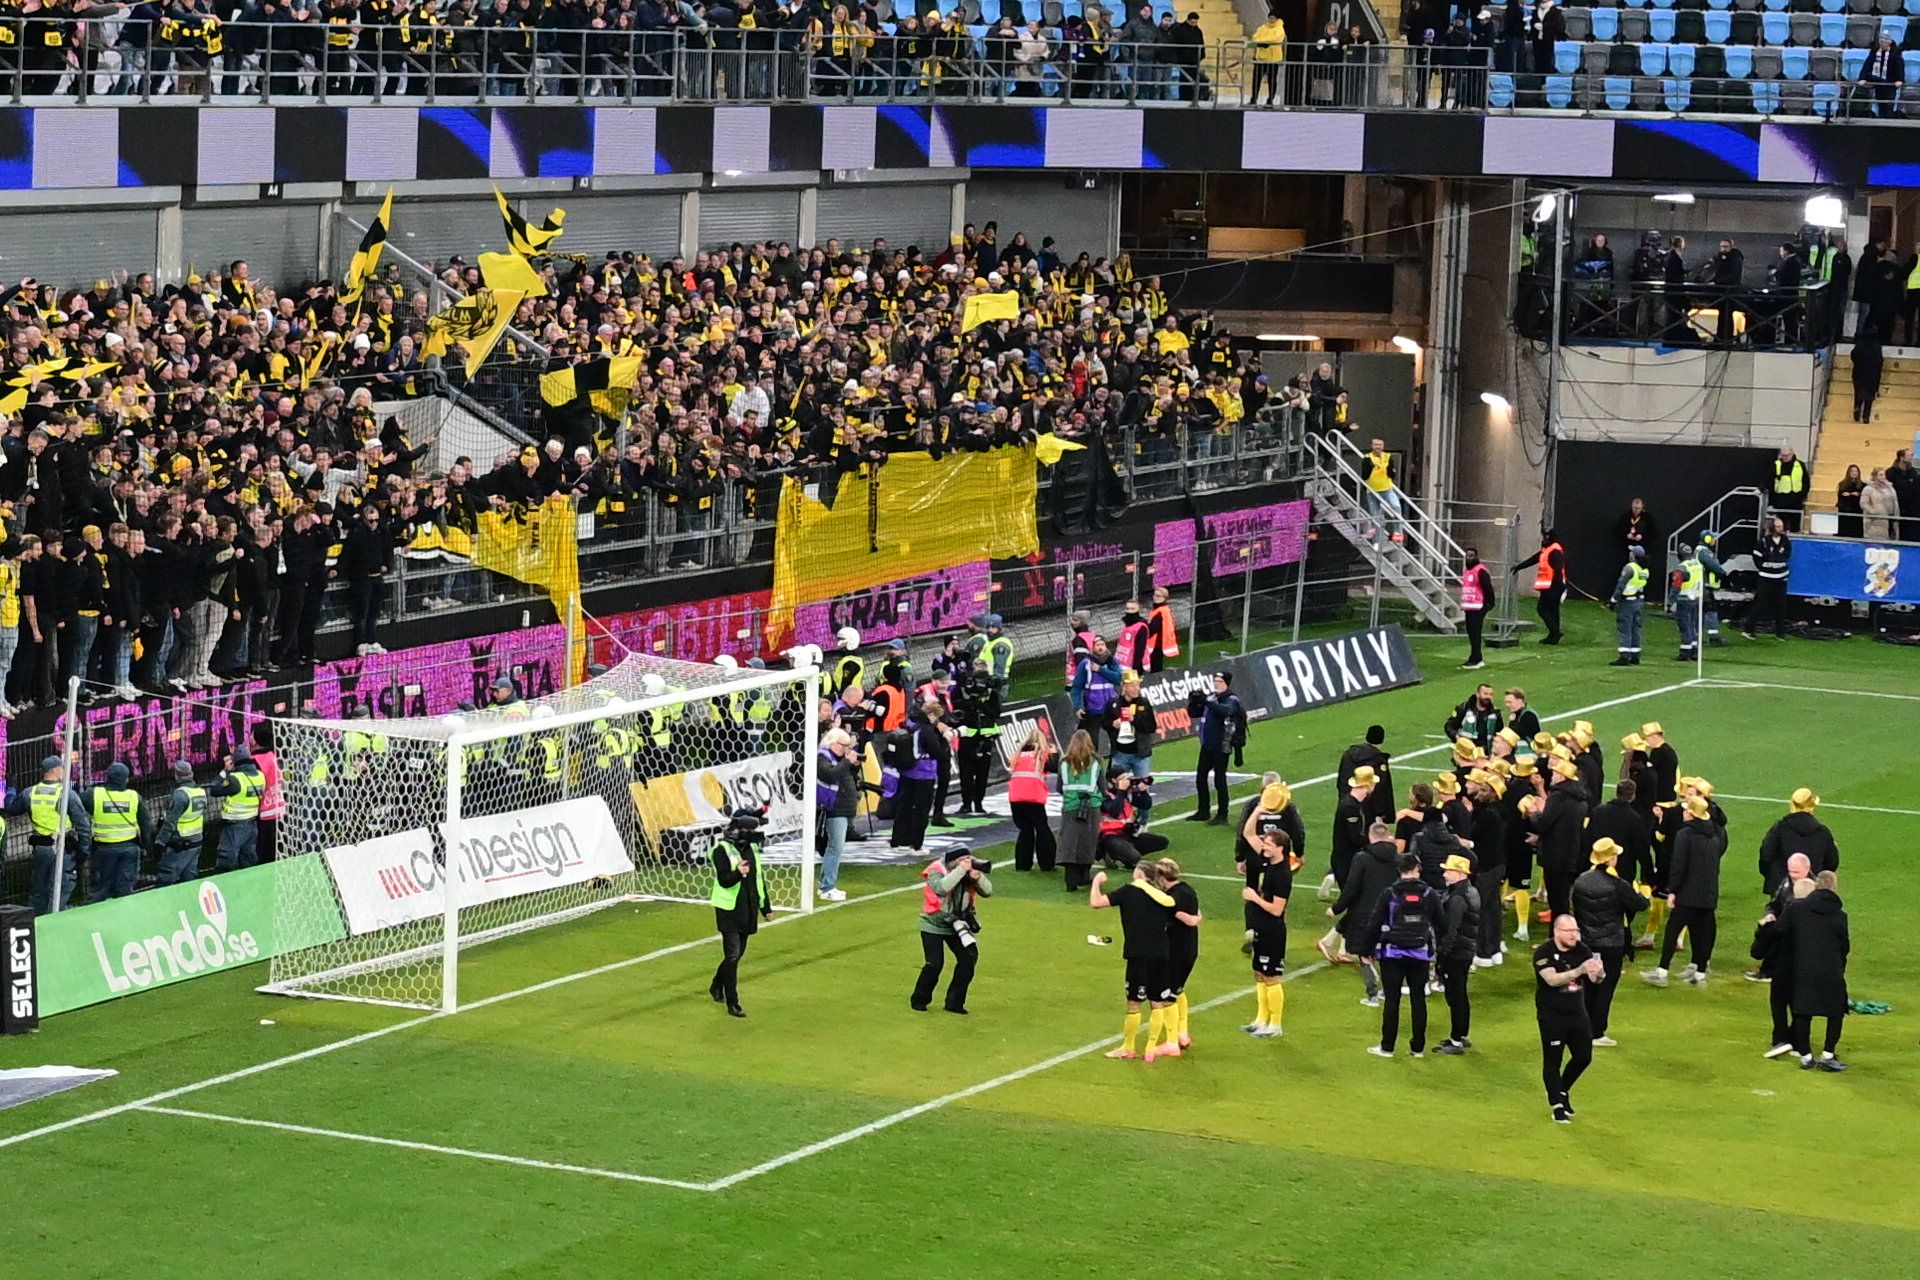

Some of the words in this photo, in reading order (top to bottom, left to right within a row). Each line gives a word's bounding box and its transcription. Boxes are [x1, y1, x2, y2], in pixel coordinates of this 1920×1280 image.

[1330, 2, 1350, 30] D1
[829, 577, 933, 636] CRAFT
[1265, 630, 1397, 708] BRIXLY
[10, 927, 33, 1018] SELECT
